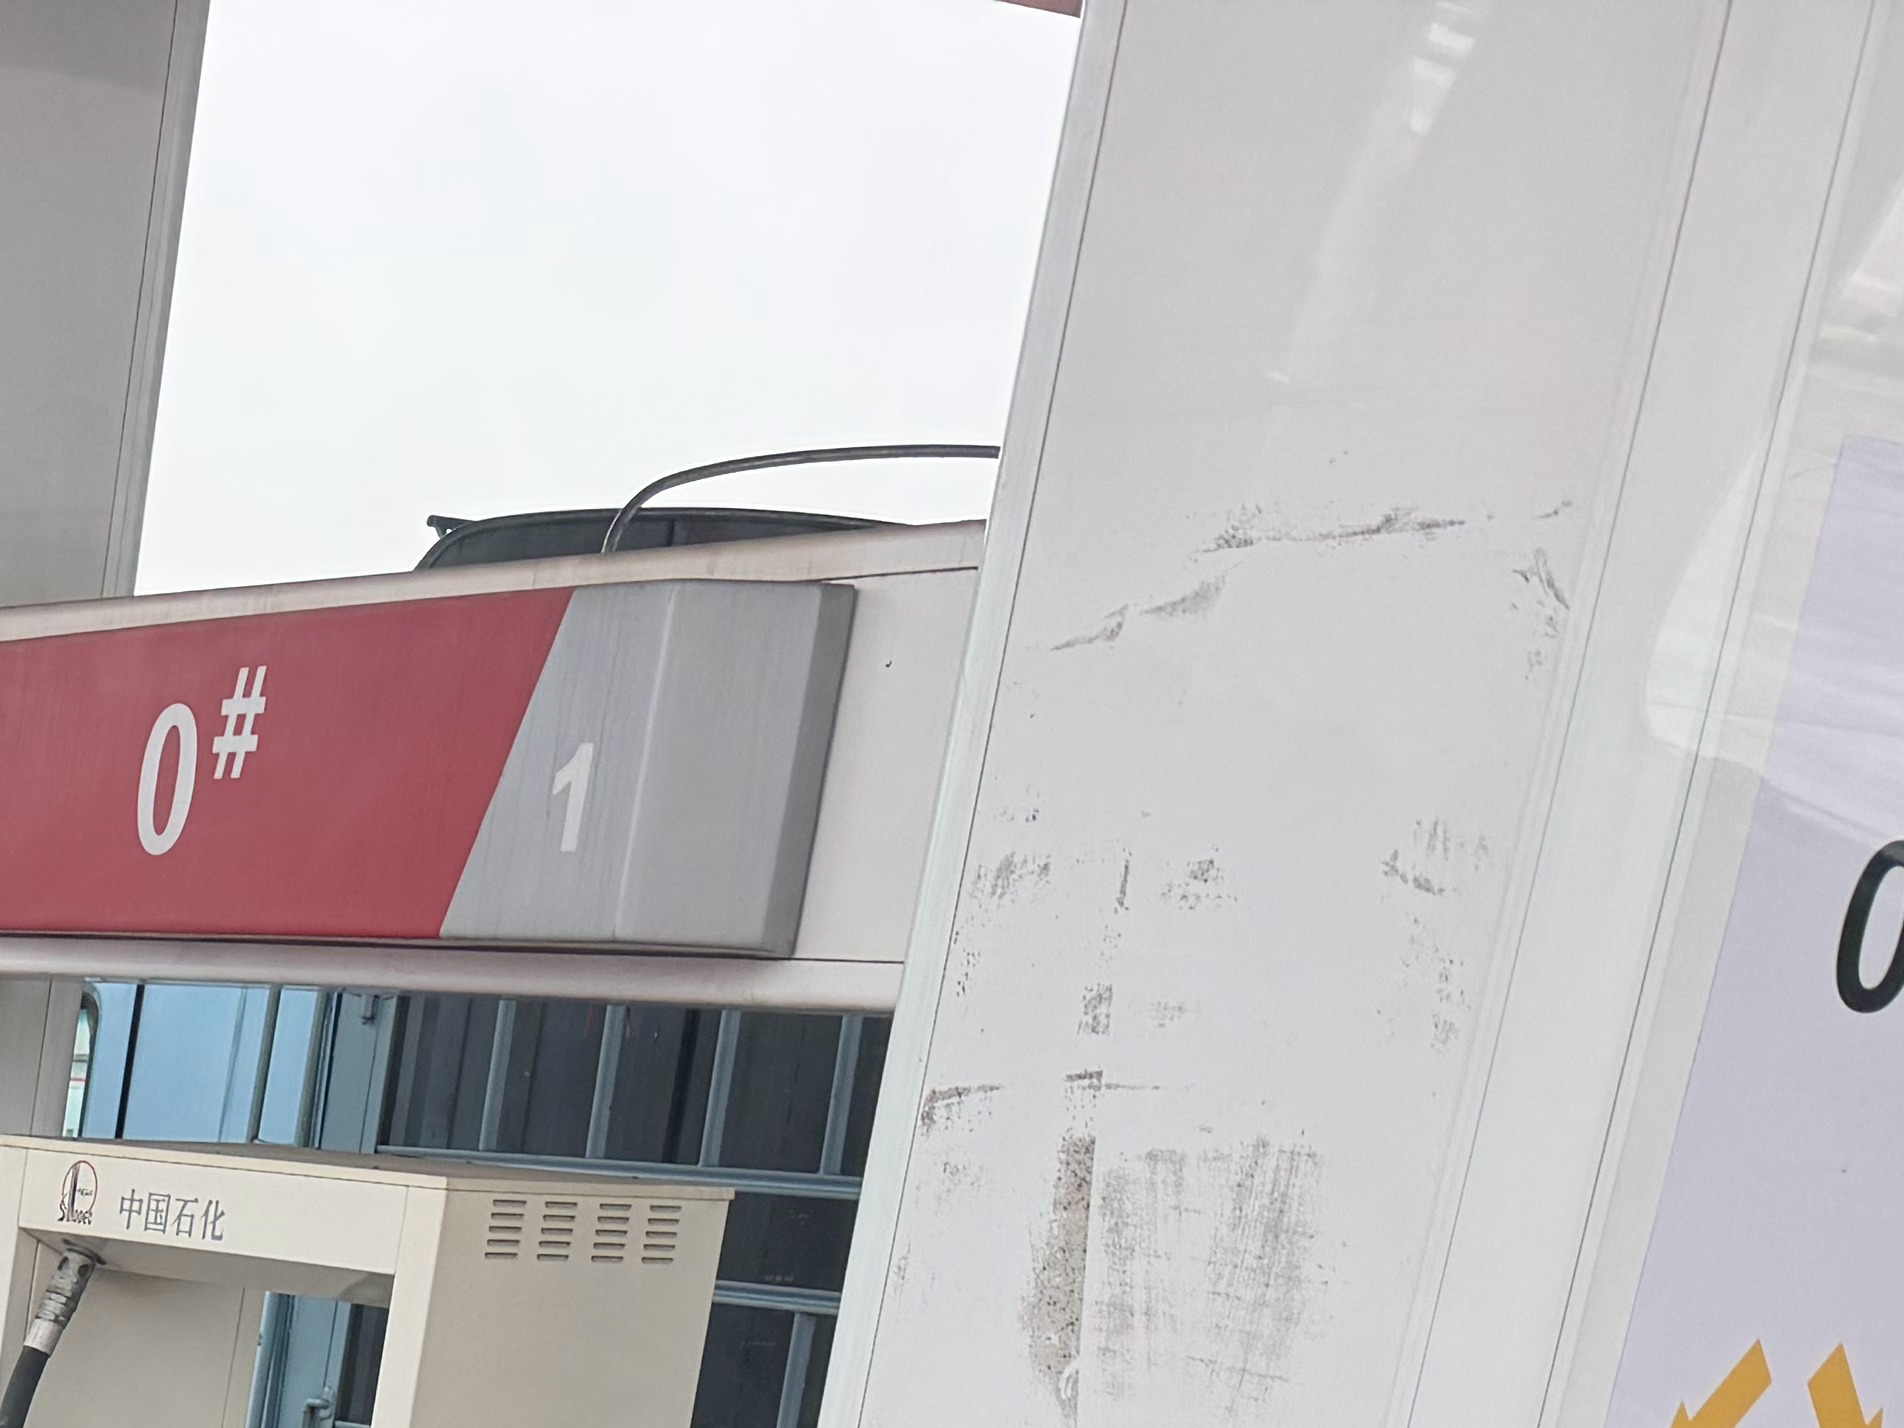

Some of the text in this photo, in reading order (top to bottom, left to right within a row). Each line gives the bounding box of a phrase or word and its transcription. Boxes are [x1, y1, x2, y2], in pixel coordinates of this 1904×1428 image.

[135, 665, 267, 857] 0#
[551, 741, 595, 853] 1
[120, 1188, 226, 1242] 中国石化
